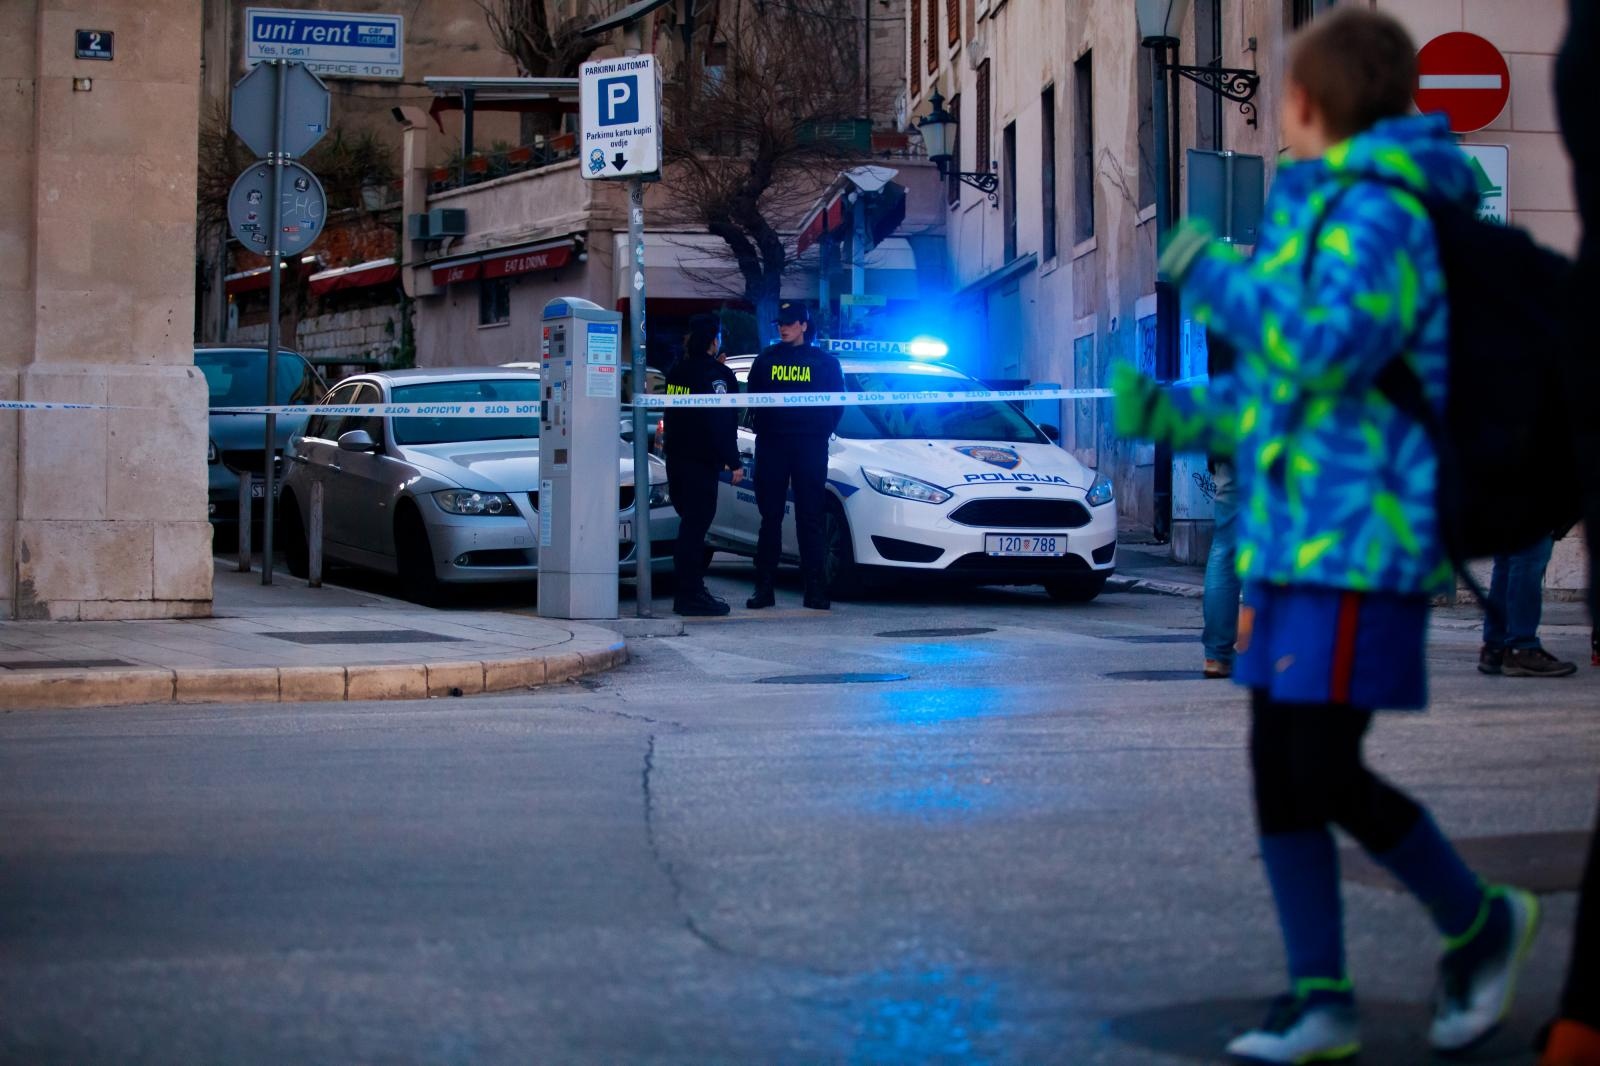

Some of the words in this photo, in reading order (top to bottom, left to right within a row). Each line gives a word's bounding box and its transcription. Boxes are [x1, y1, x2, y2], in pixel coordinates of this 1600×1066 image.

[256, 20, 296, 40] uni
[302, 24, 351, 42] rent
[90, 33, 101, 50] 2
[361, 35, 388, 43] rental
[258, 44, 278, 56] Yes,
[287, 48, 304, 56] can
[363, 66, 382, 75] 10
[585, 64, 616, 76] PARKIRNI
[616, 60, 650, 72] AUTOMAT
[608, 82, 630, 120] P
[586, 130, 614, 140] Parkirnu
[615, 128, 632, 138] kartu
[633, 126, 652, 136] kupiti
[610, 139, 628, 148] ovdje
[505, 258, 518, 272] EAT
[526, 254, 549, 270] DRINK
[831, 341, 900, 352] POLICIJA
[771, 365, 810, 382] POLICIJA
[963, 473, 1071, 485] POLICIJA
[1000, 537, 1021, 552] 120
[1032, 538, 1056, 552] 788
